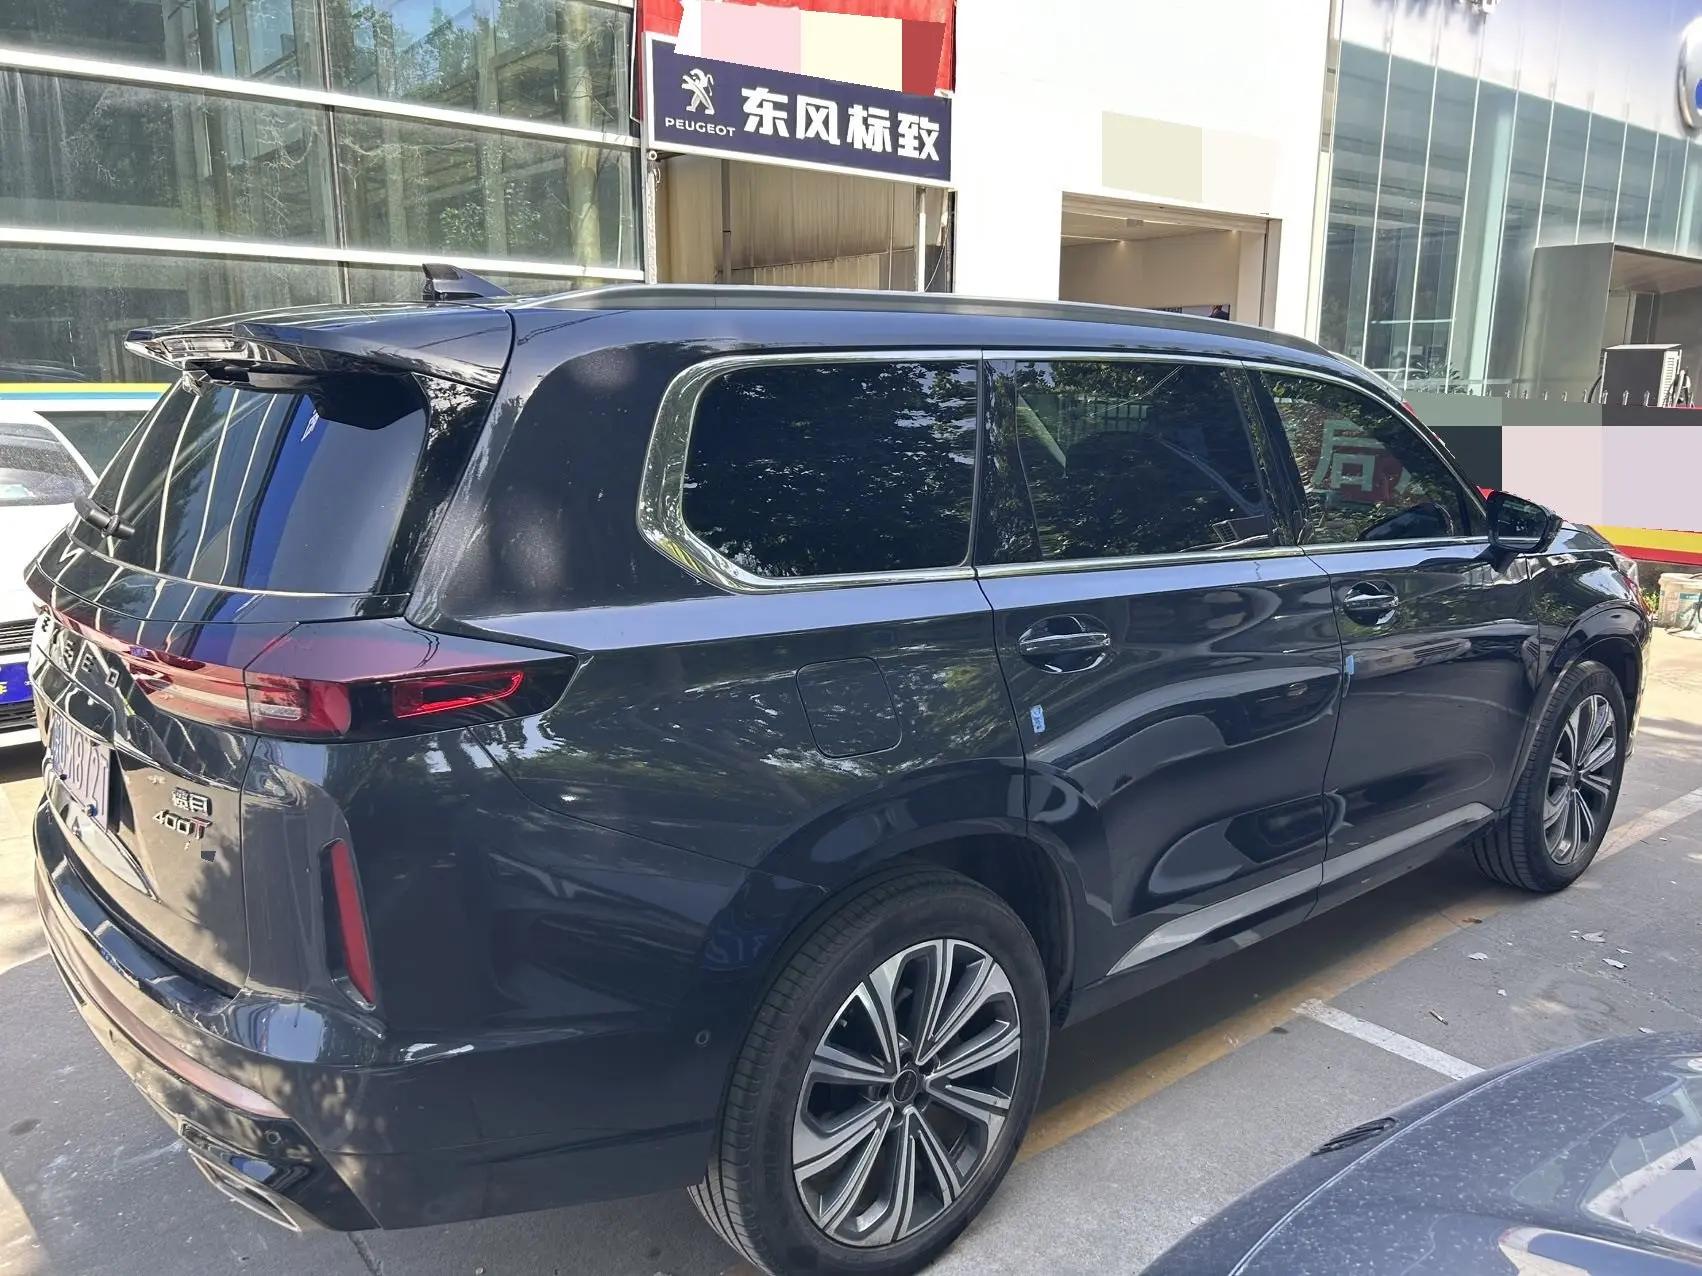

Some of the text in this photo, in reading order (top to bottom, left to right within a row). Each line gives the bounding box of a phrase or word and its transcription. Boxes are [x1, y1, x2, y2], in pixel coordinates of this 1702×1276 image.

[664, 116, 736, 137] PEUGEOT
[741, 87, 940, 161] 东风标致
[1312, 418, 1411, 494] 后
[152, 810, 212, 840] 400T
